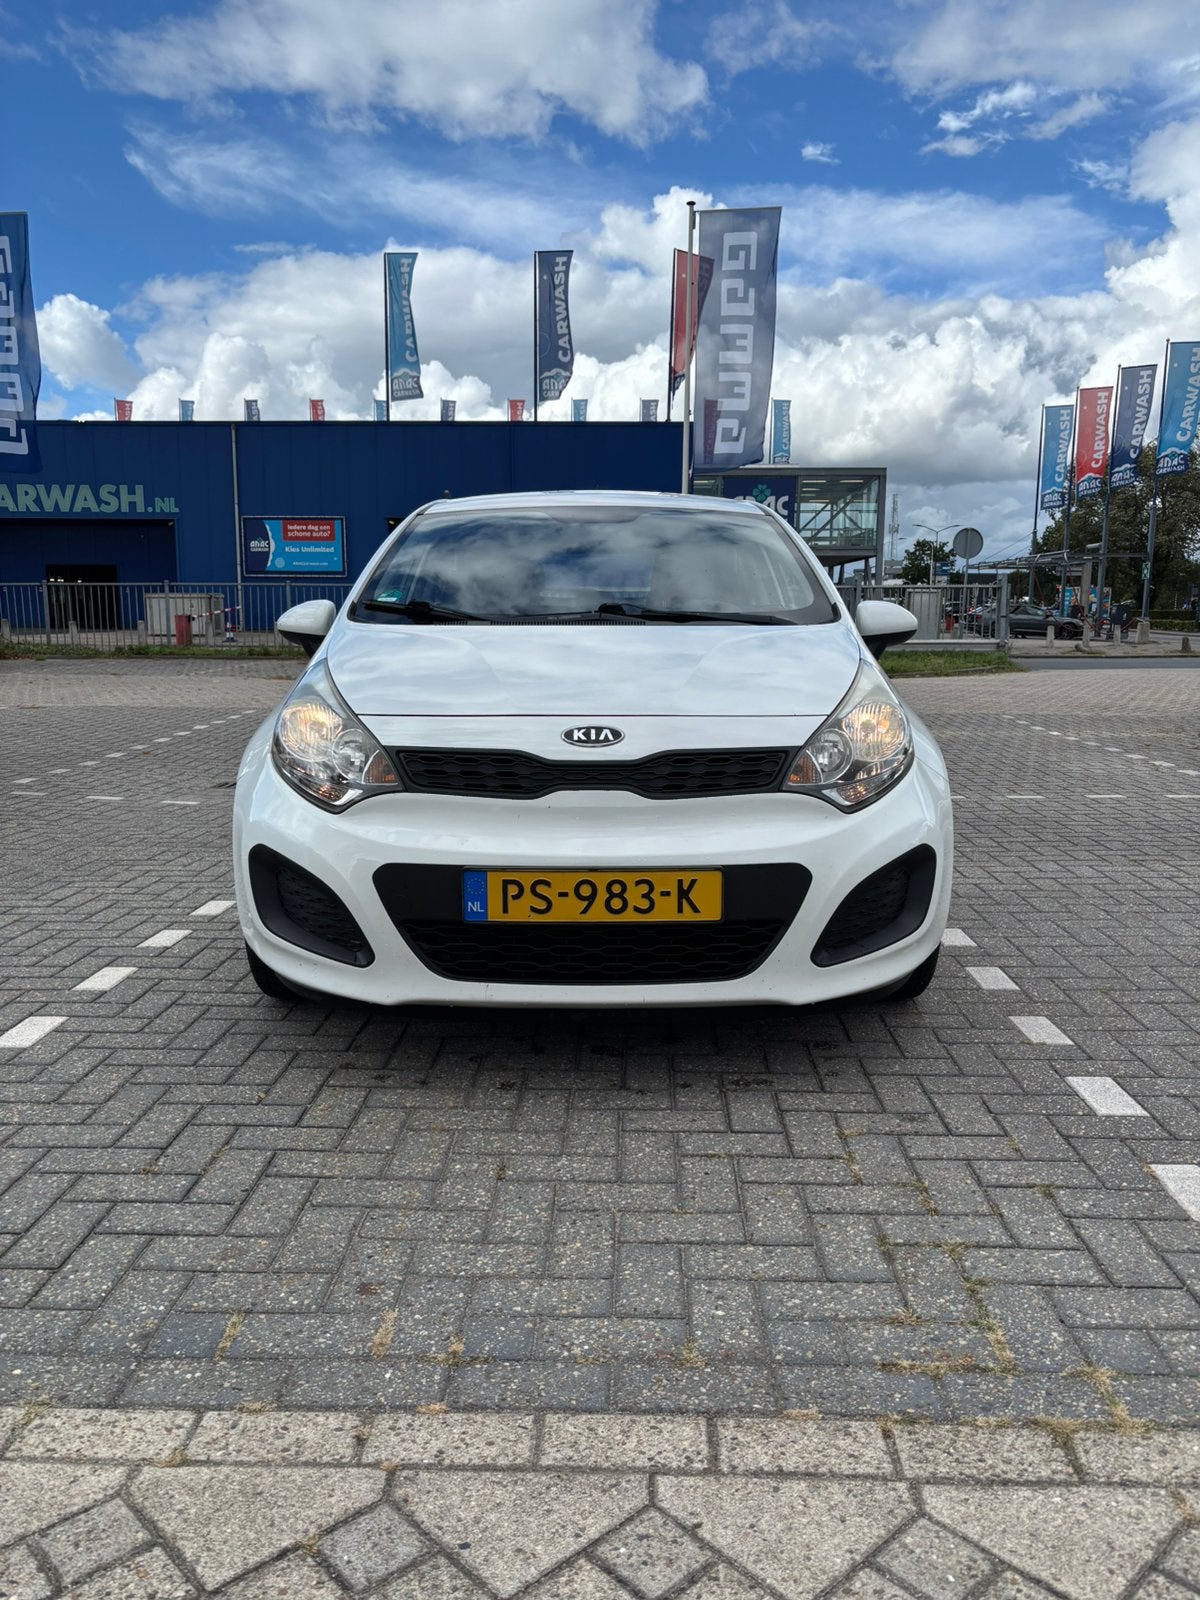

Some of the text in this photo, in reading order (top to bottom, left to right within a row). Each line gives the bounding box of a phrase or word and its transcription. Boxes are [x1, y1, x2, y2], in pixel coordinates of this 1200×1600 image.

[554, 256, 571, 363] CARWASH
[1091, 391, 1109, 468] CARWASH
[1129, 369, 1153, 459] CARWASH
[1054, 409, 1071, 482] CARWASH
[1155, 464, 1185, 475] CARWASH
[573, 728, 614, 741] KIA
[467, 901, 485, 912] NL
[501, 878, 701, 915] PS-983-K
